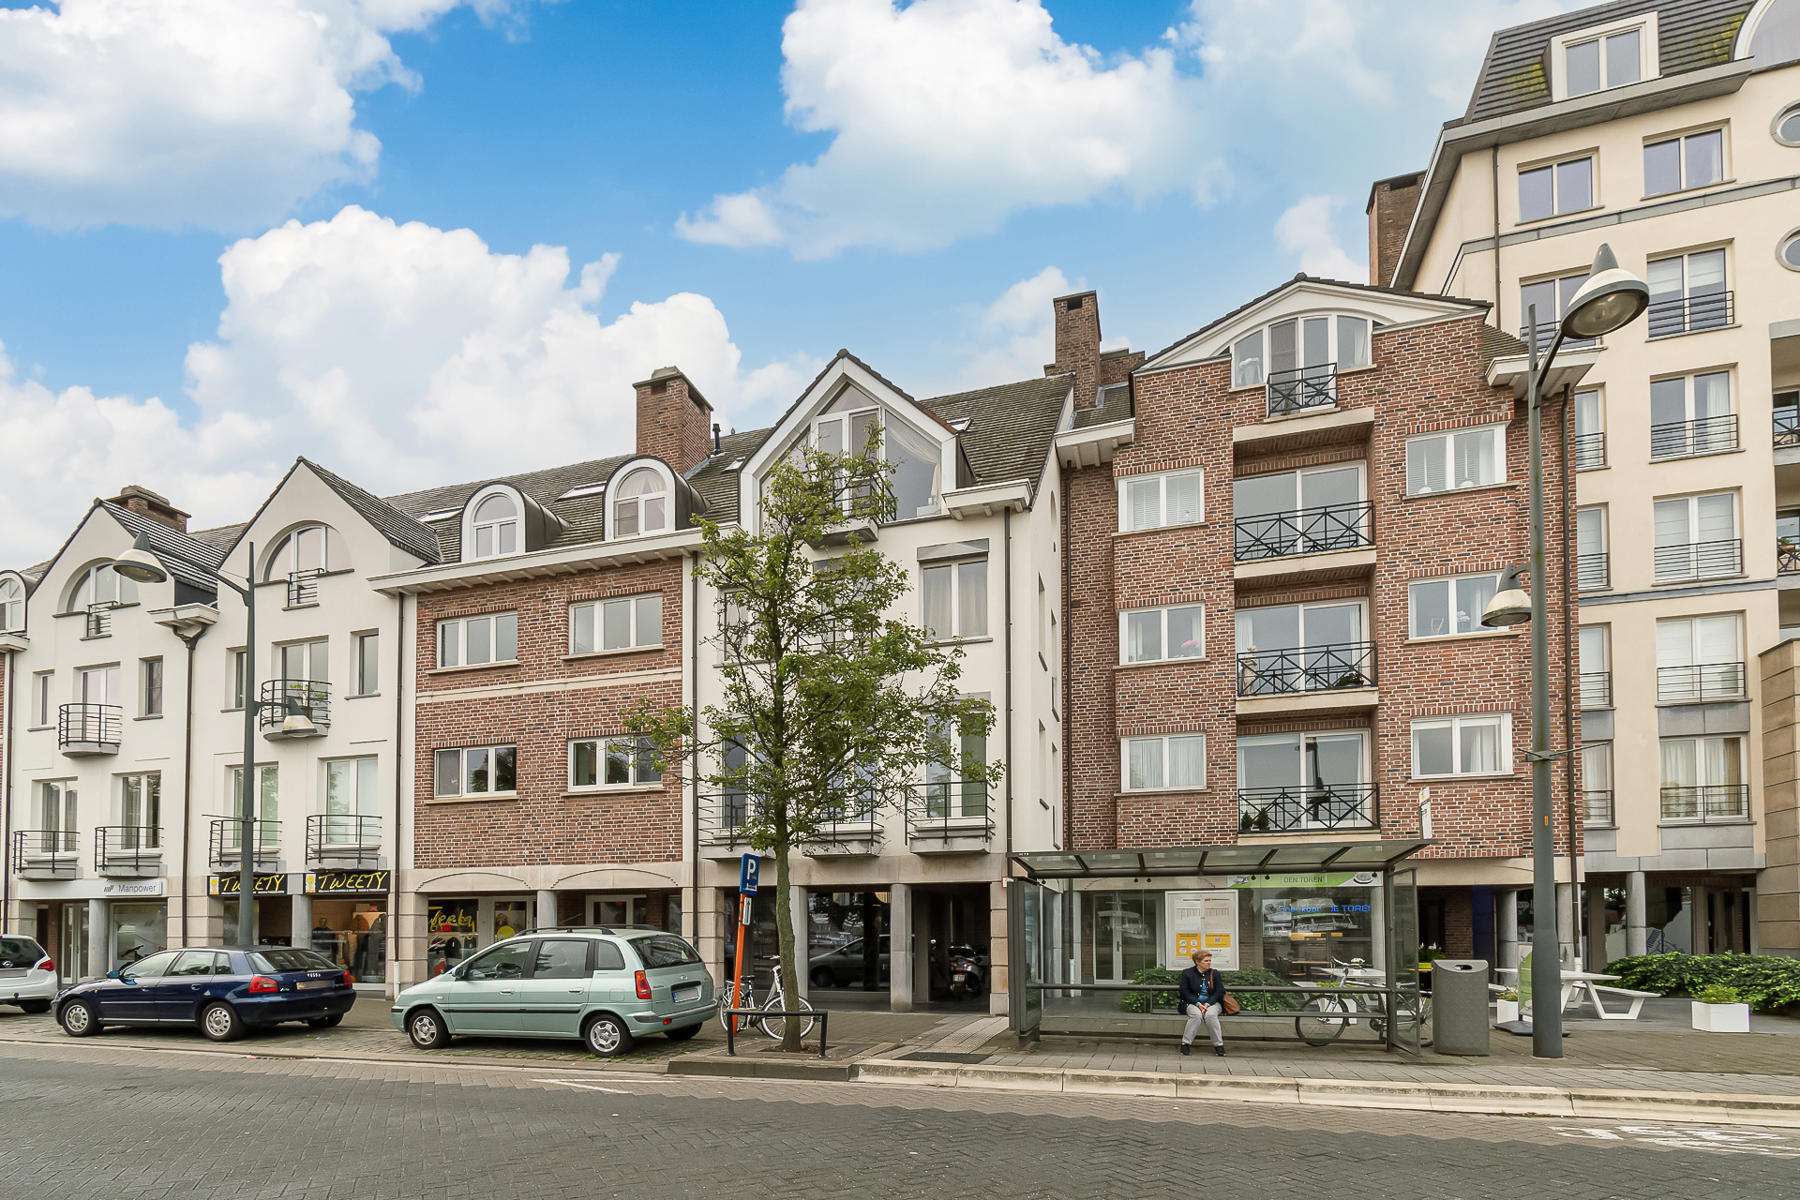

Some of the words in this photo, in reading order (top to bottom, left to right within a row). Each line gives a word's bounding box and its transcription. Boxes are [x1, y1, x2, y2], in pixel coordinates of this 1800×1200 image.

[747, 858, 756, 880] P
[118, 884, 156, 894] Manpower
[318, 872, 388, 890] TWEETY
